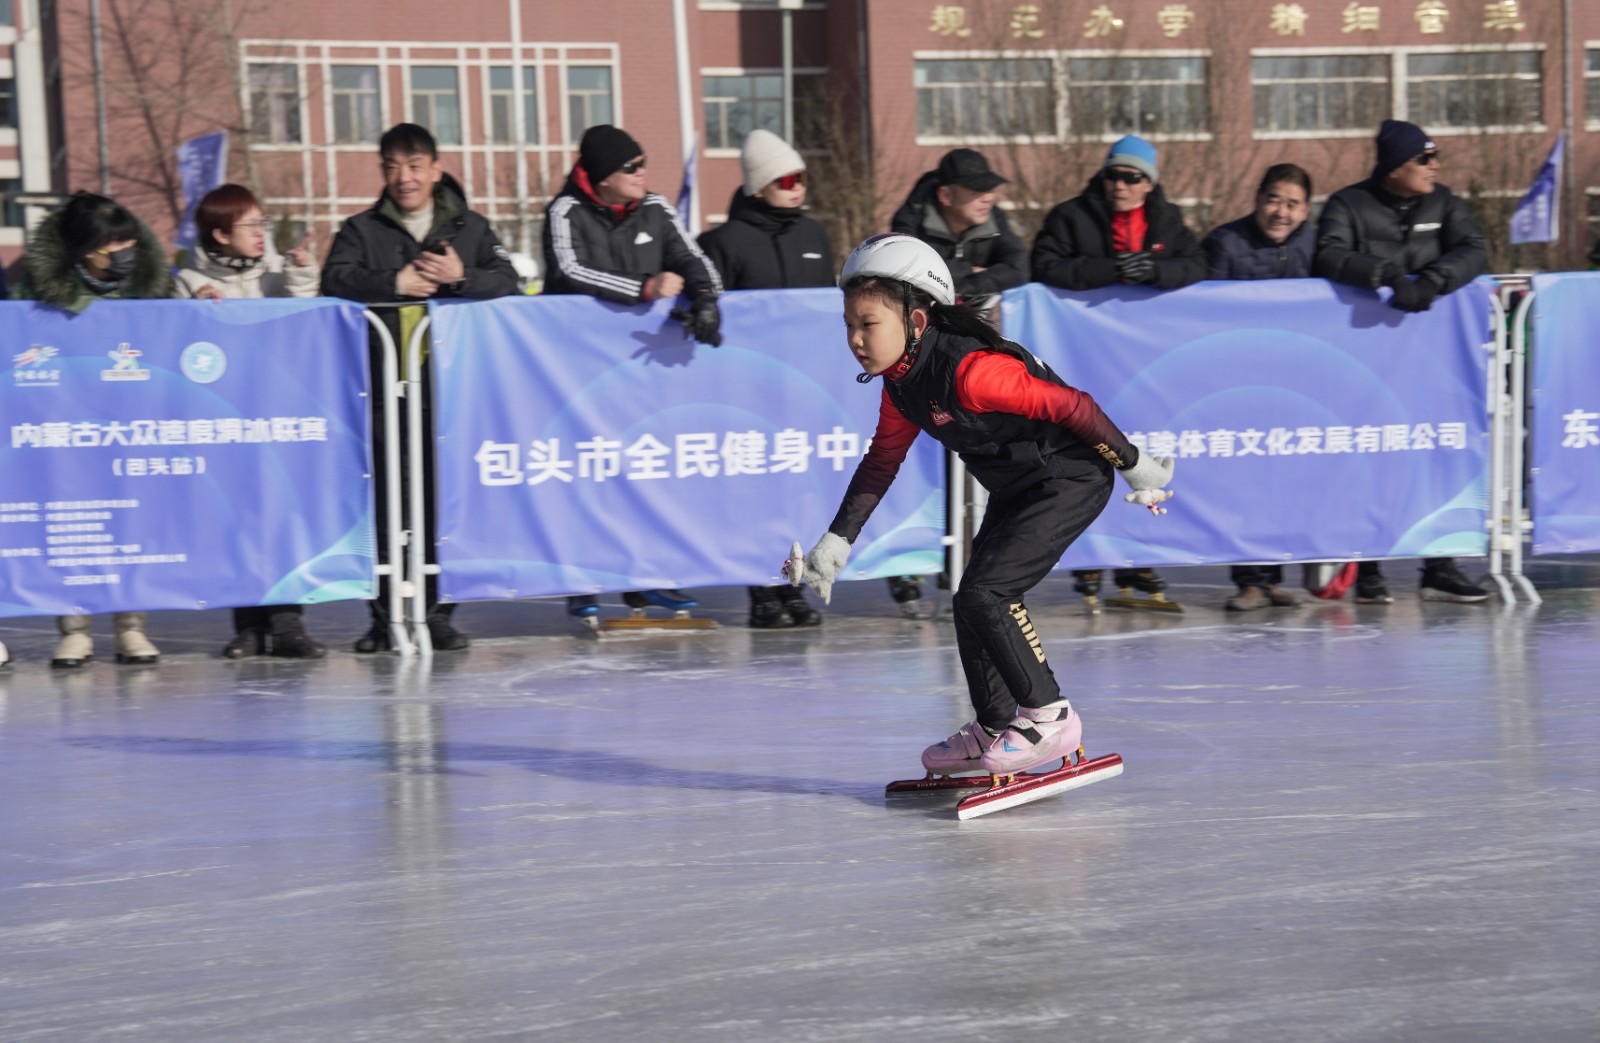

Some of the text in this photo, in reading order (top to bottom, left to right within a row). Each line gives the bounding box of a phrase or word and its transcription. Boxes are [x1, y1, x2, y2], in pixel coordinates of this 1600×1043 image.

[928, 0, 1526, 38] 规范办学 精细管理
[11, 416, 328, 448] 内蒙古大众速度滑冰联赛
[473, 426, 873, 486] 包头市全民健身中
